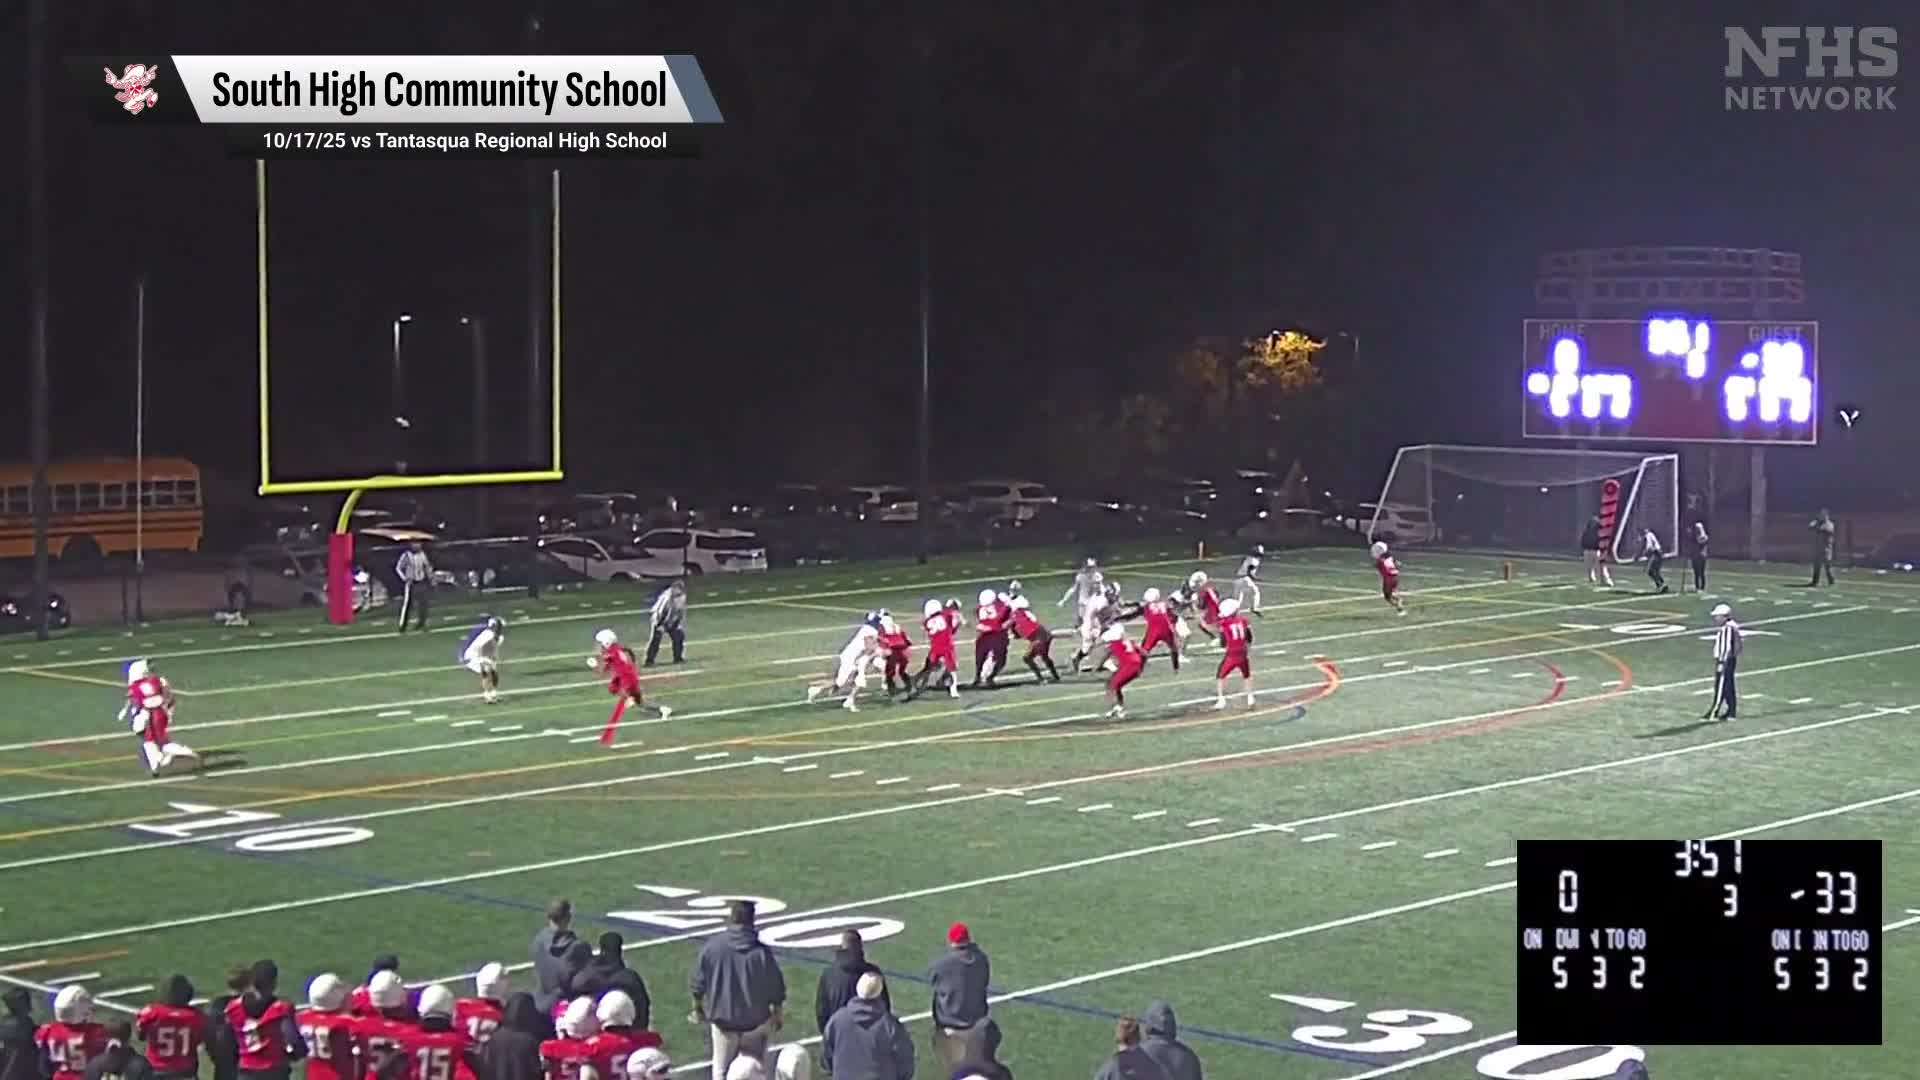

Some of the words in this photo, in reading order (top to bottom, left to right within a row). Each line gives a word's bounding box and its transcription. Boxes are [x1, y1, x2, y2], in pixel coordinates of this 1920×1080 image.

[48, 1033, 87, 1072] 45
[157, 1026, 191, 1057] 51
[415, 1046, 451, 1080] 15
